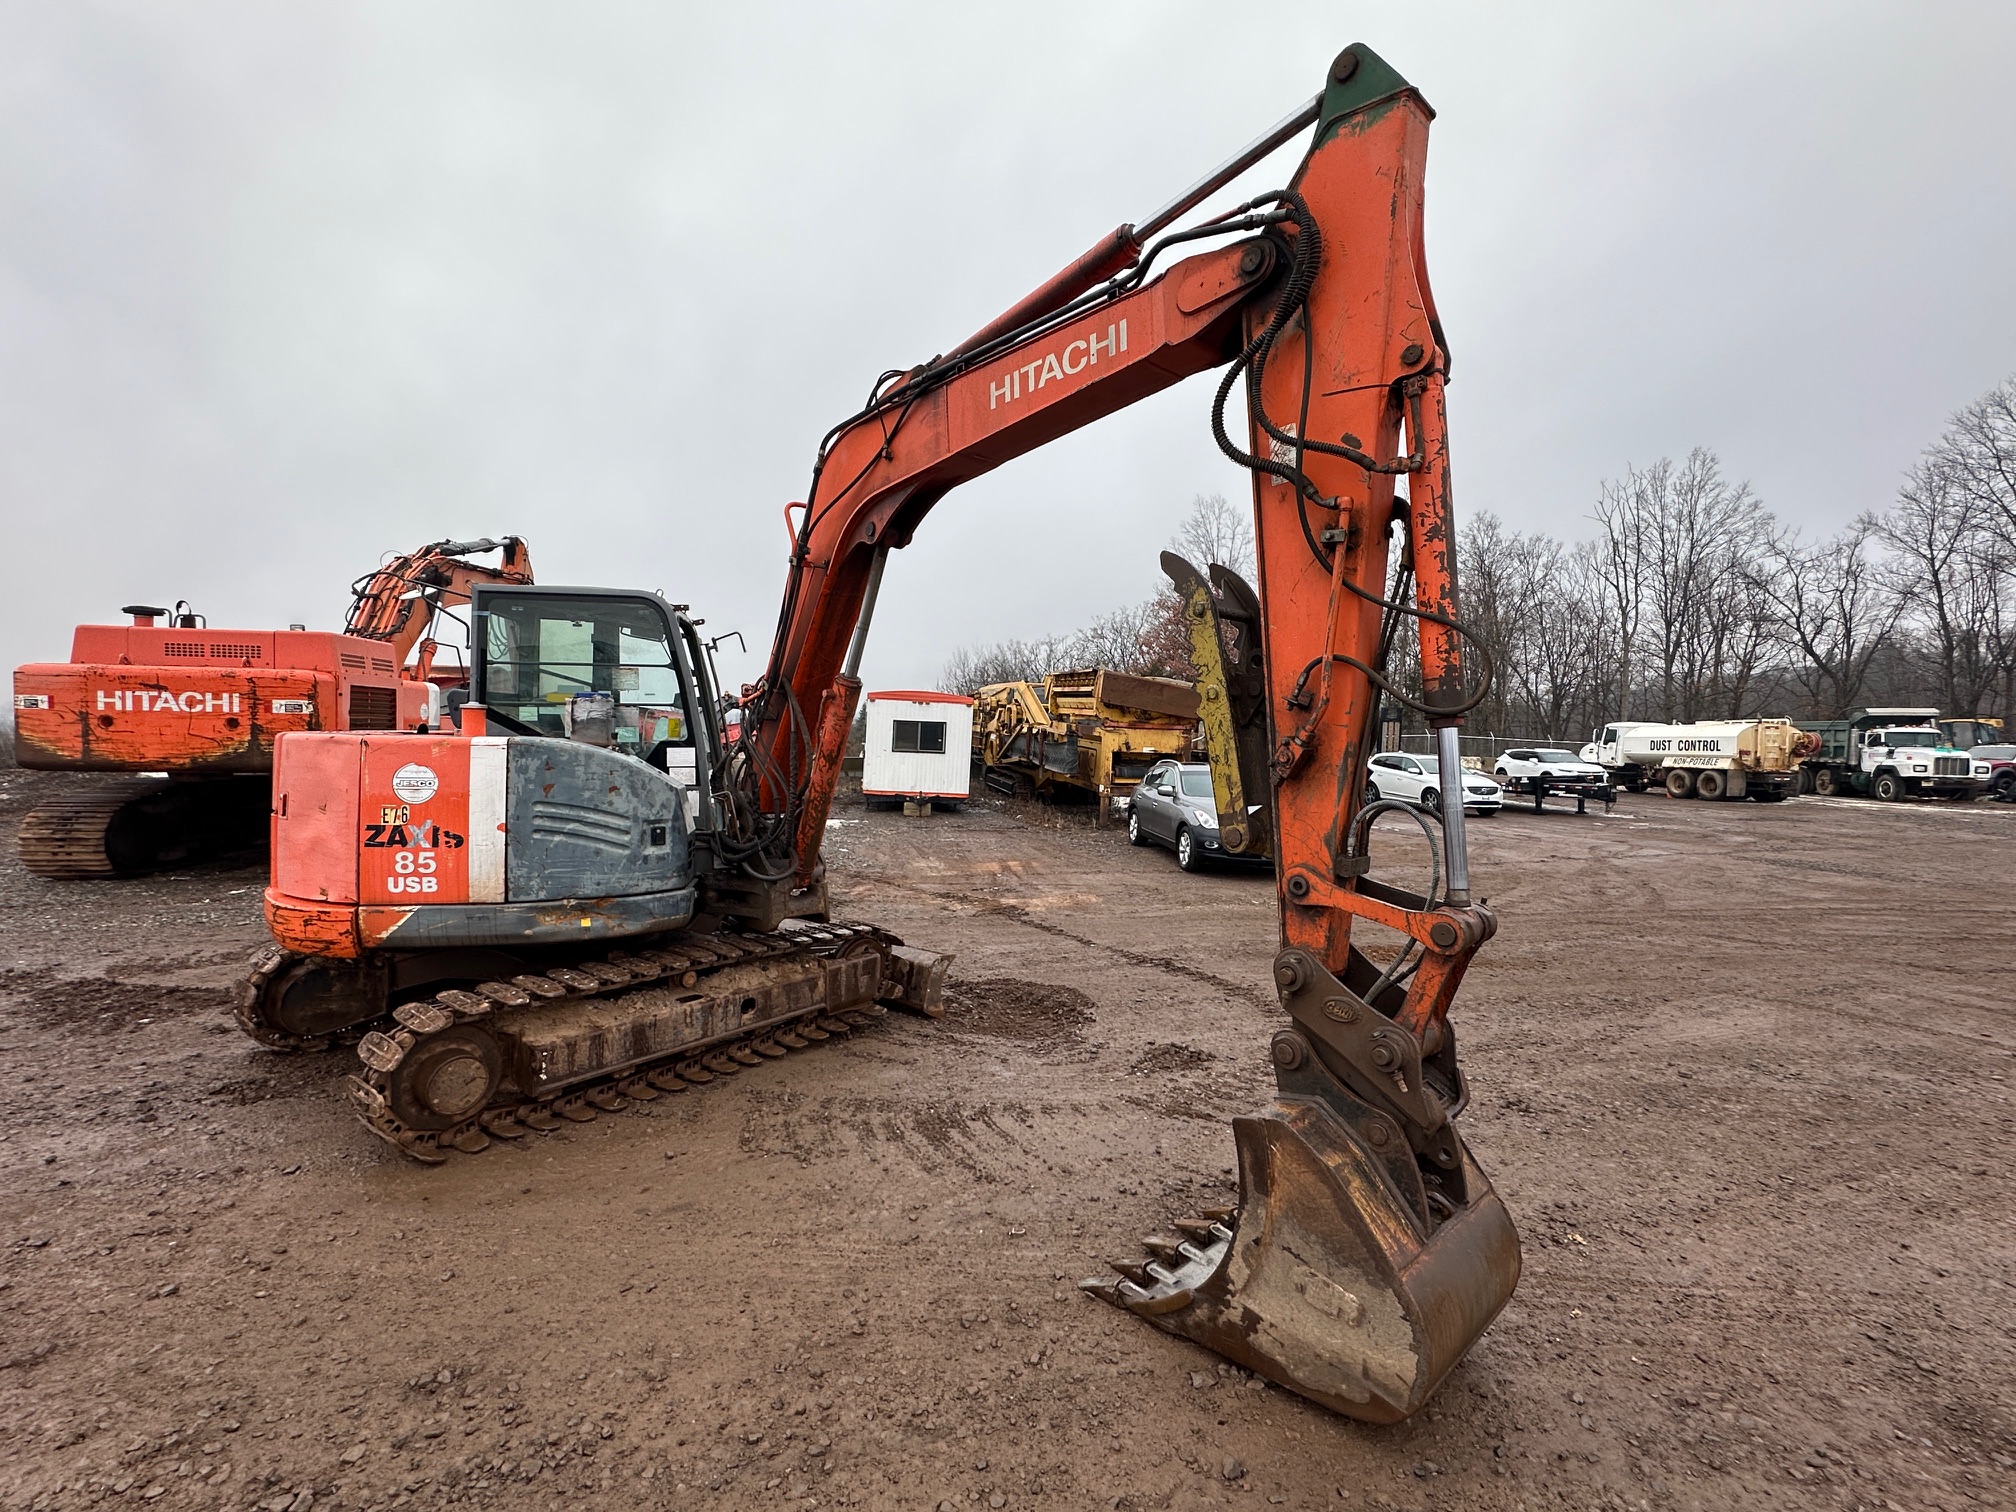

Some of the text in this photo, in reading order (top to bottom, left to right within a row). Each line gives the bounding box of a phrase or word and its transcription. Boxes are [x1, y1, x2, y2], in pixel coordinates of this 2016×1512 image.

[989, 318, 1128, 410] HITACHI
[96, 690, 241, 713] HITACHI
[1649, 739, 1722, 752] DUST CONTROL
[1672, 757, 1720, 766] NON-POTABLE
[395, 779, 436, 788] JESCO
[394, 851, 438, 875] 85
[387, 876, 439, 894] USB
